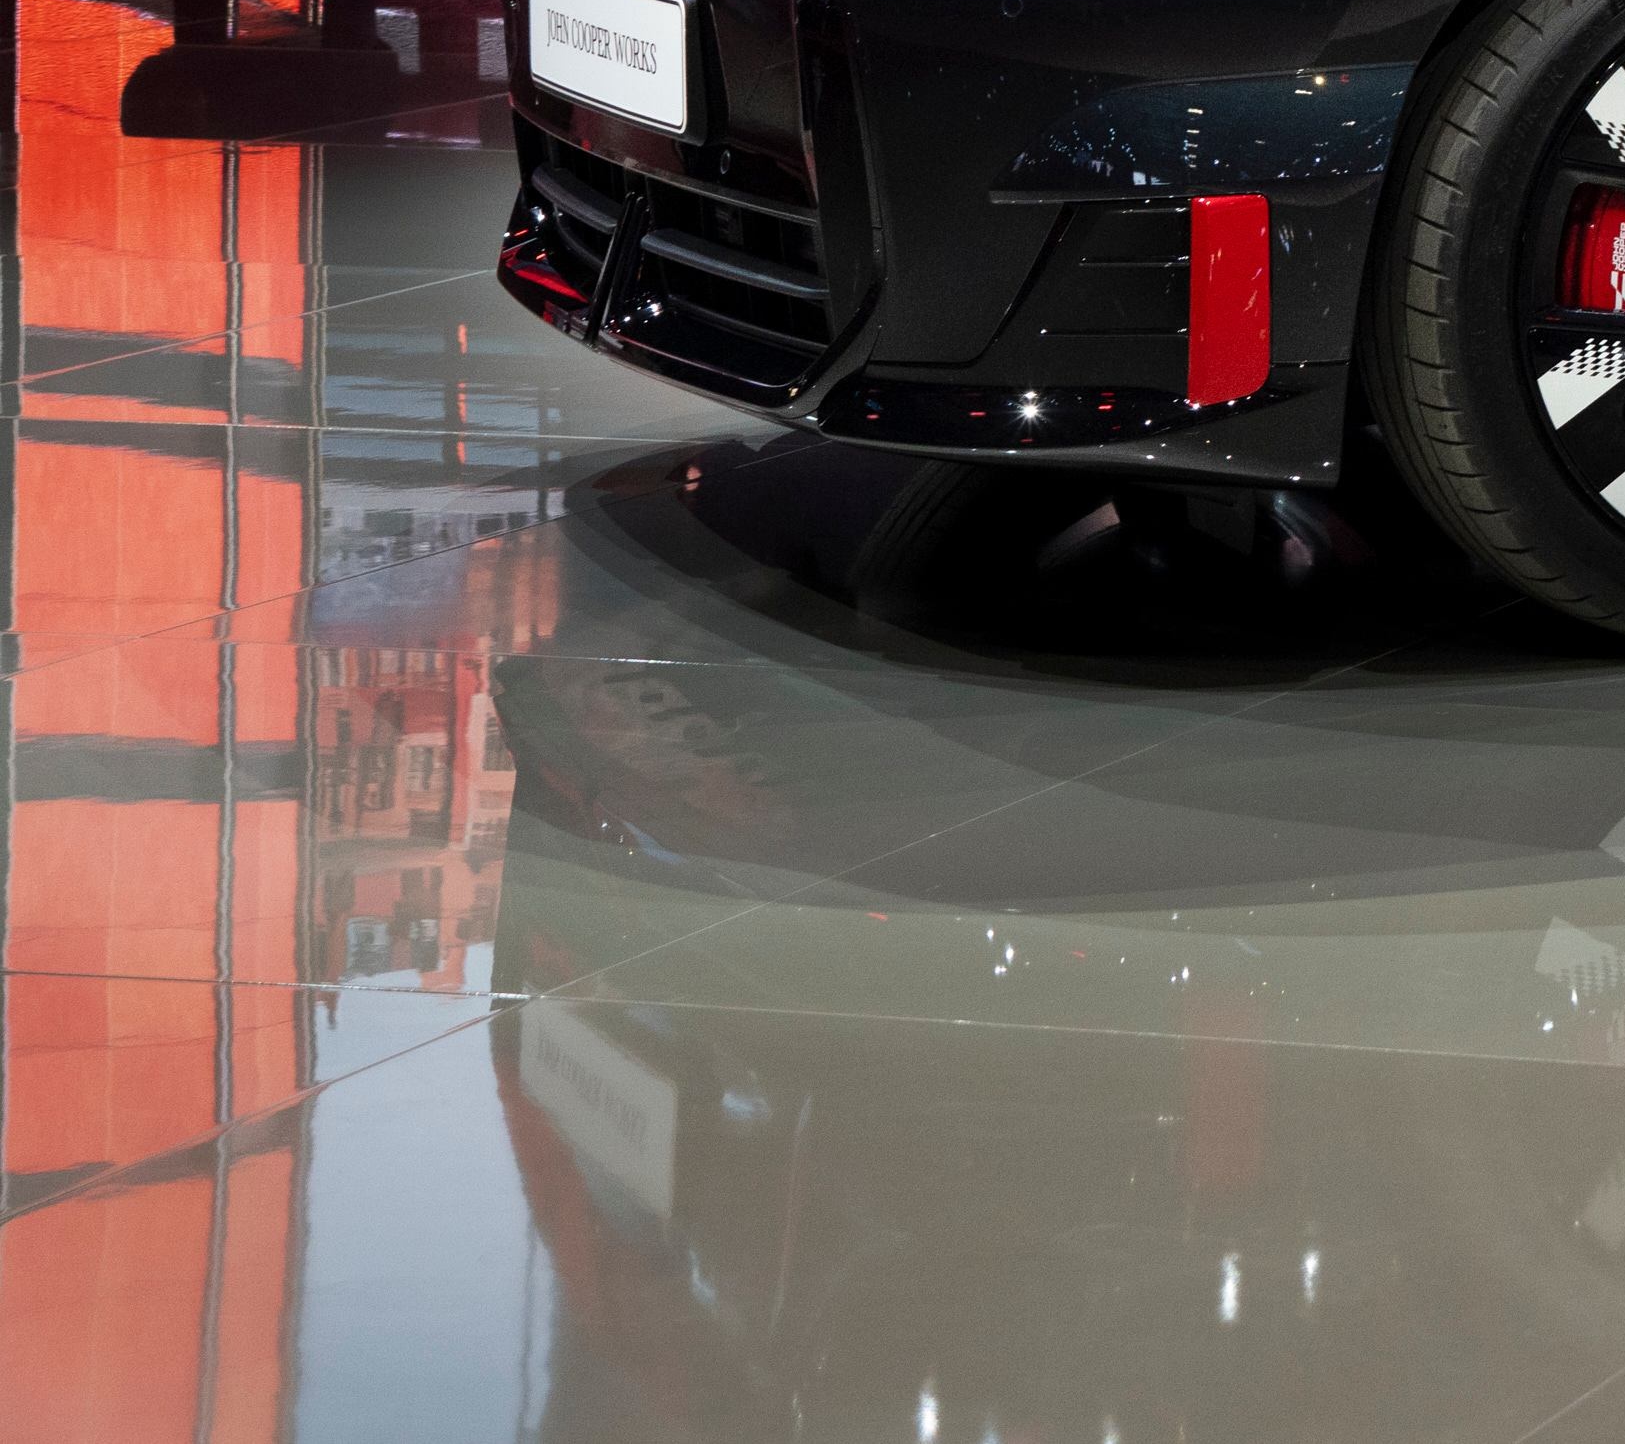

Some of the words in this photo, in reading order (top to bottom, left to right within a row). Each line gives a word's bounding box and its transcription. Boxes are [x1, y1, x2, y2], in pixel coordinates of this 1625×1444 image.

[546, 8, 571, 47] JOHN
[571, 18, 612, 61] COOPER
[613, 31, 658, 75] WORKS
